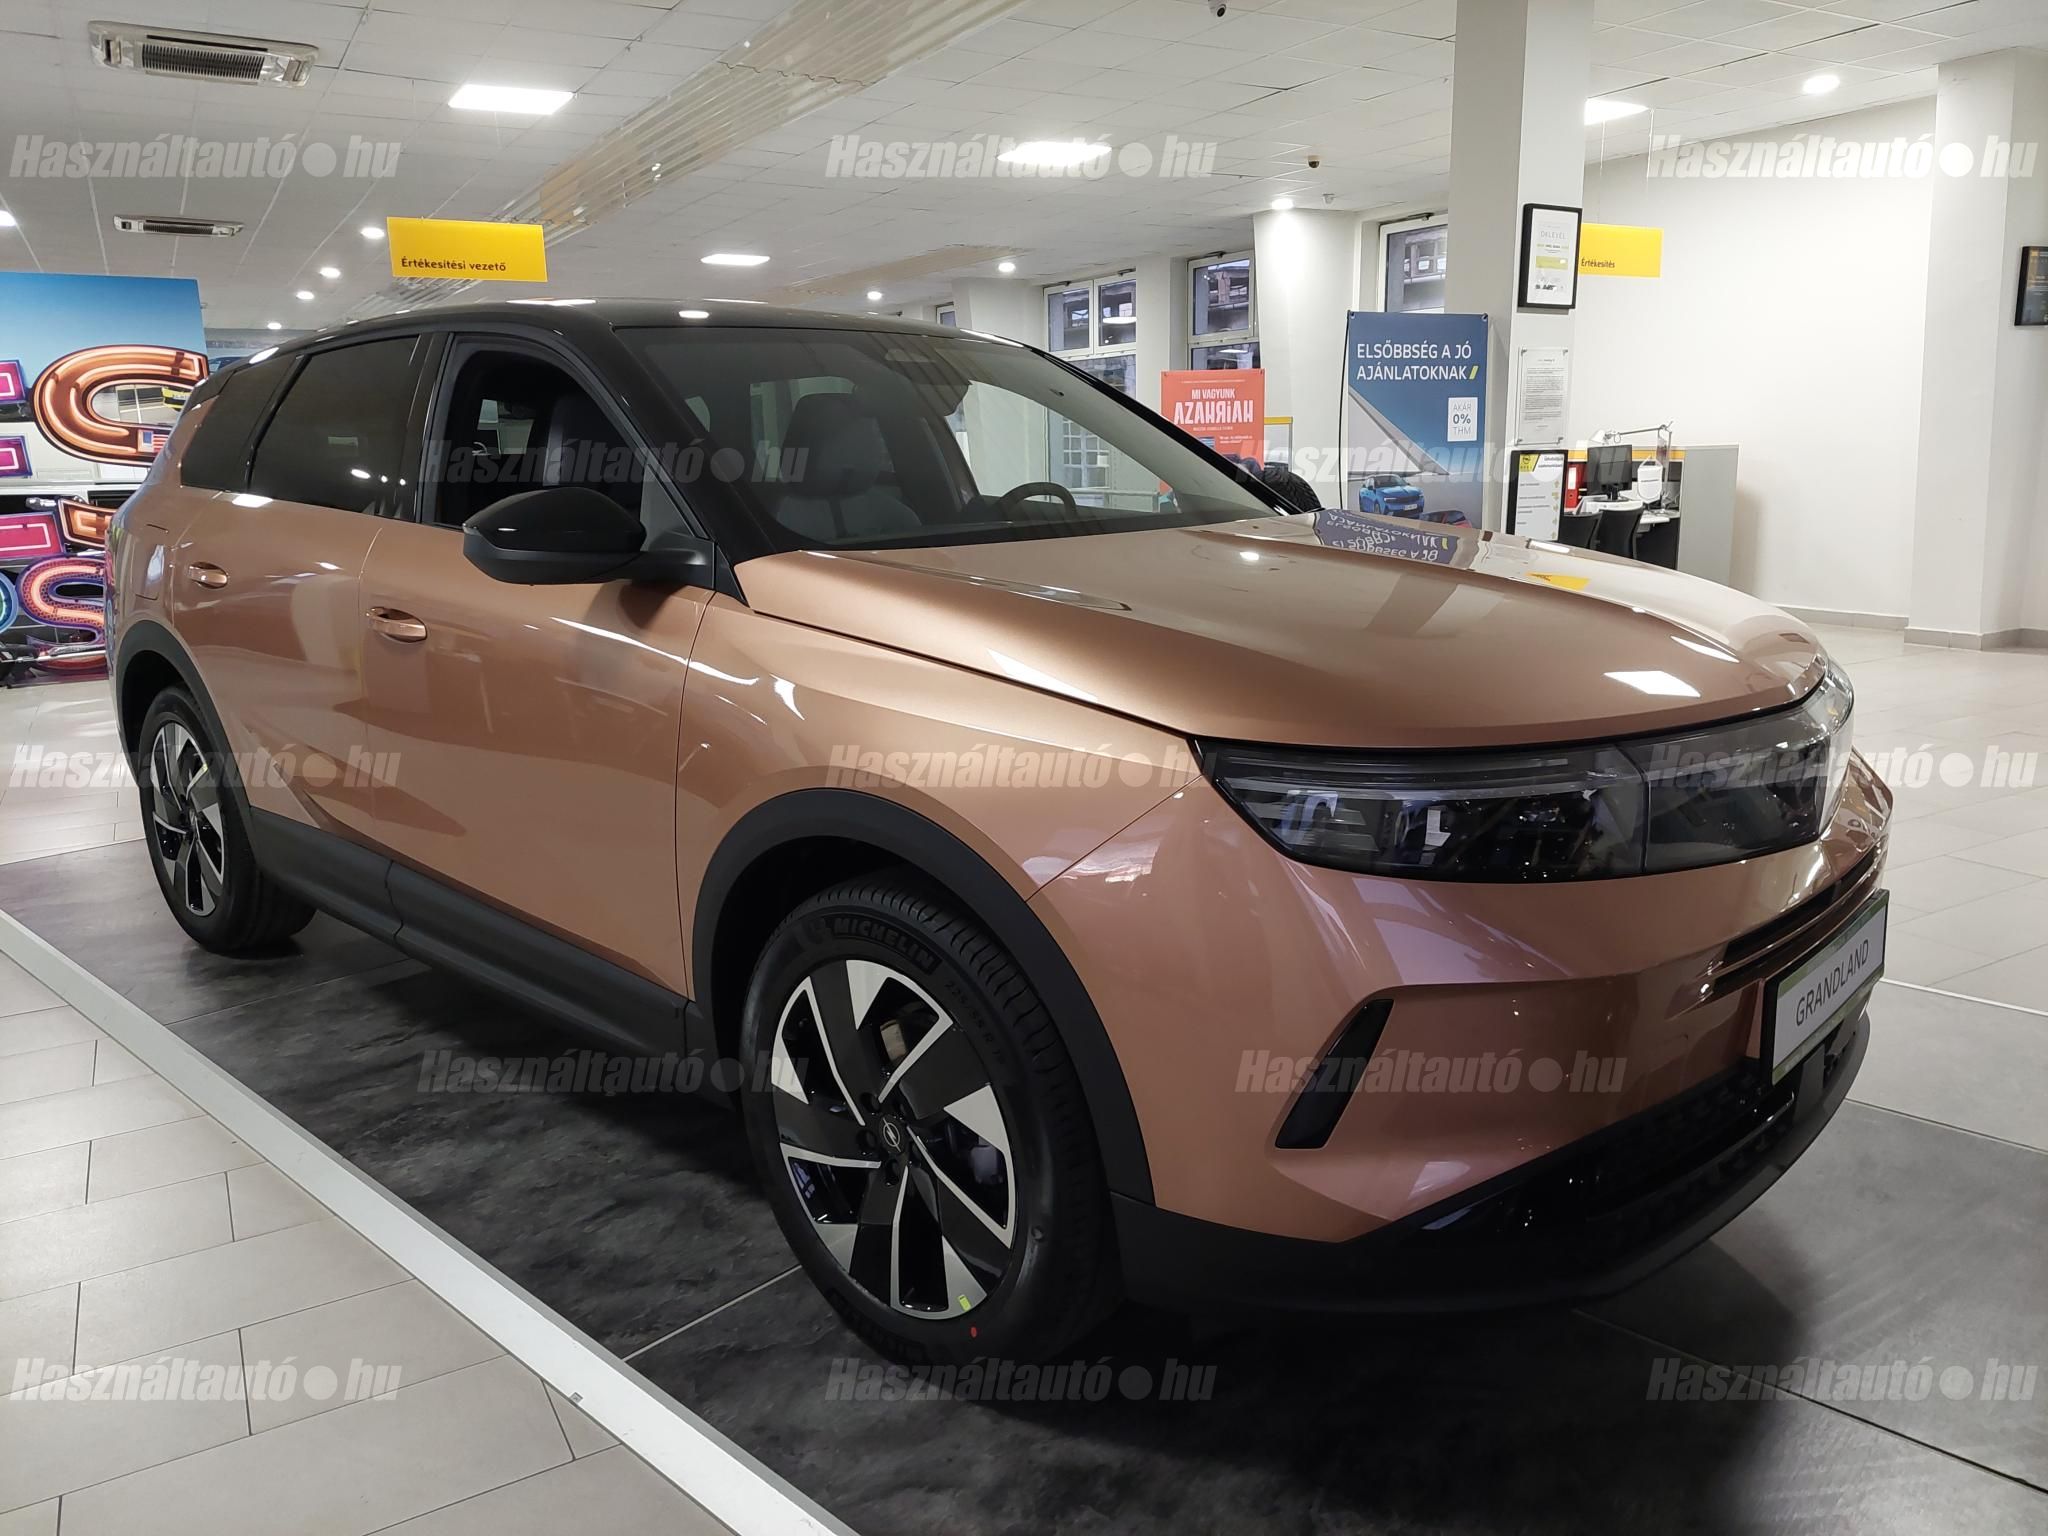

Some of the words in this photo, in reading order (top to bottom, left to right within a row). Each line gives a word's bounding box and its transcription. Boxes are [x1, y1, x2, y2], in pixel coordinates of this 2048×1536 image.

[401, 256, 466, 269] Értékesítési
[469, 260, 506, 271] vezető
[1581, 258, 1616, 269] Értékesítés
[1357, 339, 1438, 359] ELSŐBBSÉG
[1441, 344, 1451, 359] A
[1454, 340, 1472, 359] JÓ
[1356, 361, 1467, 380] AJÁNLATOKNAK
[1191, 389, 1200, 400] MI
[1202, 388, 1235, 399] VAGYUNK
[1452, 413, 1471, 424] 0%
[1453, 427, 1471, 435] THM
[833, 916, 936, 970] MICHELIN
[1795, 939, 1870, 1027] GRANDLAND
